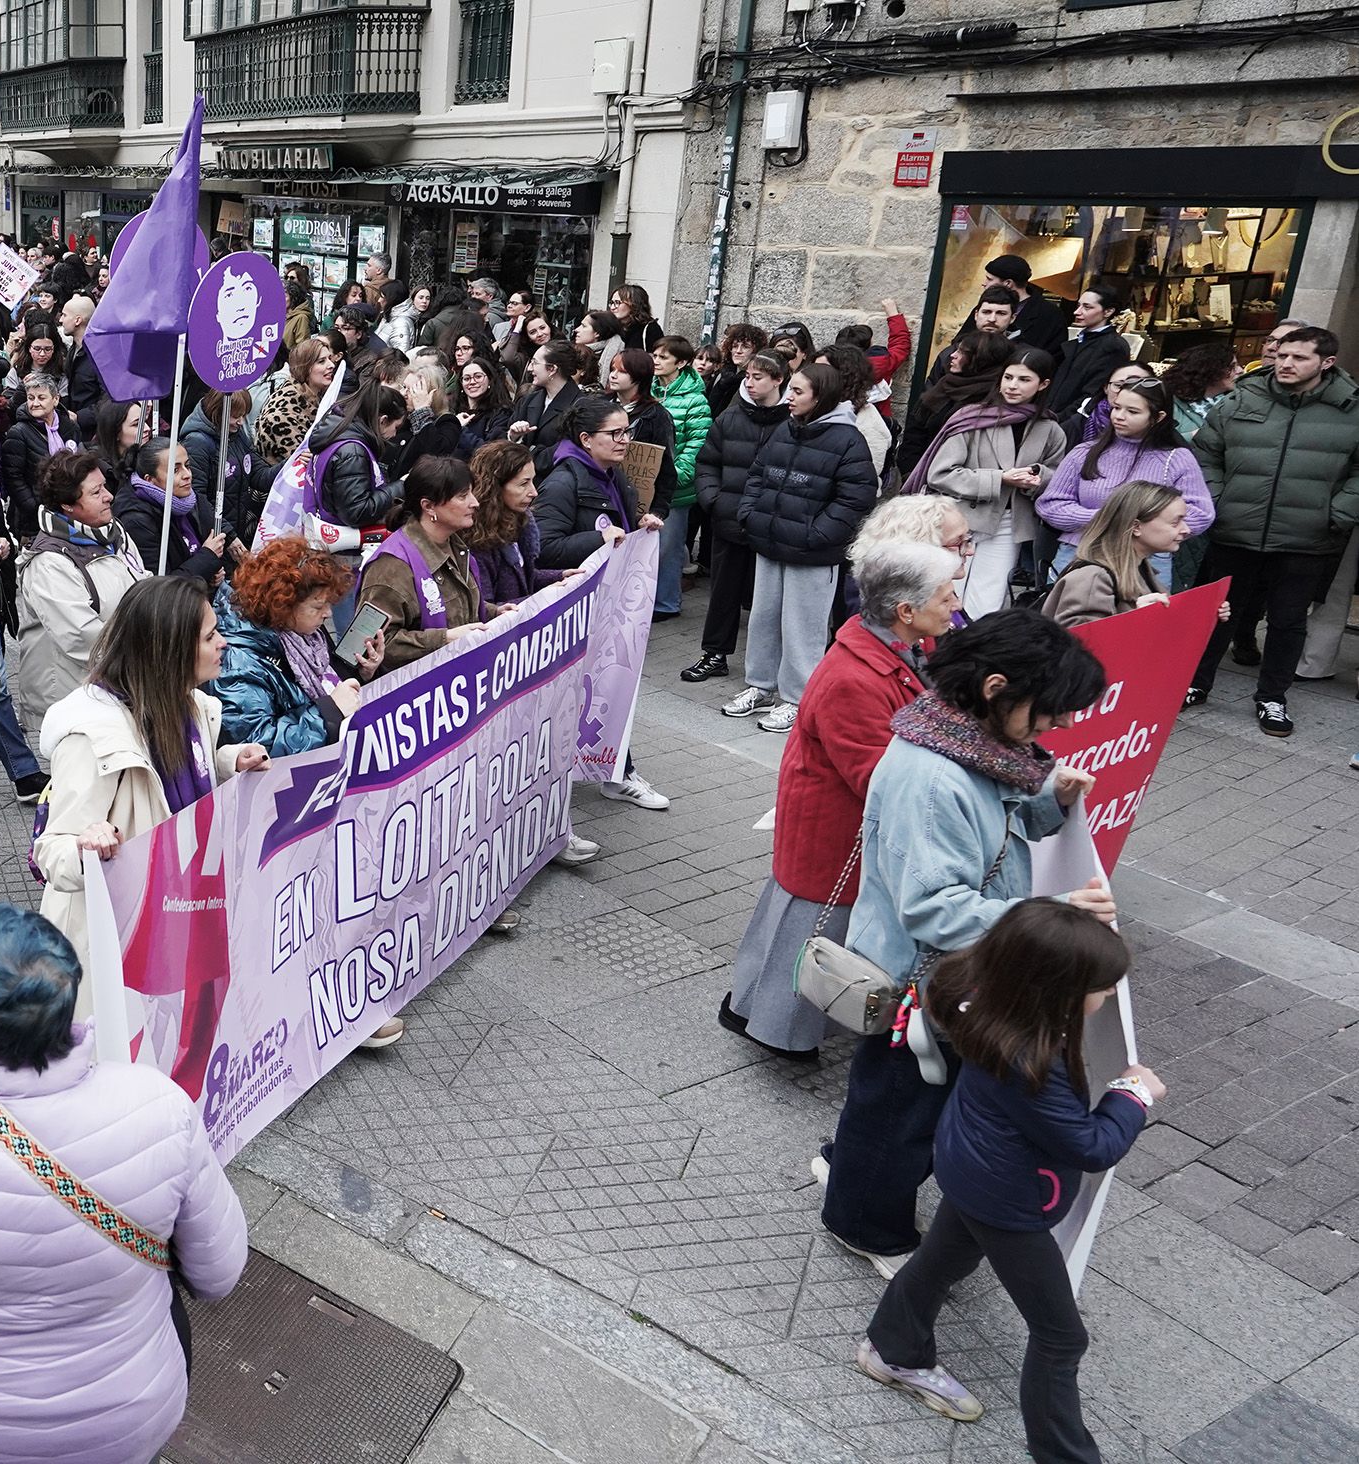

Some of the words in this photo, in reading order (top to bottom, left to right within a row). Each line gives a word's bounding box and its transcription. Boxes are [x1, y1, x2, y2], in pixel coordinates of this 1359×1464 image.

[900, 154, 931, 163] Alarma
[274, 181, 339, 198] PEDROSA
[407, 185, 500, 206] AGASALLO
[545, 187, 573, 199] galega
[507, 197, 528, 207] regalo
[538, 199, 572, 208] souvenirs
[292, 219, 342, 237] PEDROSA
[216, 337, 254, 357] feminismo
[221, 348, 249, 370] galego
[236, 360, 256, 376] clase
[646, 447, 657, 464] A
[476, 669, 489, 715] E
[271, 866, 318, 974] EN
[335, 752, 478, 924] LOITA
[484, 717, 552, 822] POLA
[309, 912, 422, 1050] NOSA
[219, 1017, 288, 1106] MARZO
[203, 1042, 230, 1133] 8
[229, 1049, 241, 1074] DE
[216, 1069, 269, 1134] internacional
[268, 1055, 284, 1078] das
[235, 1063, 293, 1125] traballadoras
